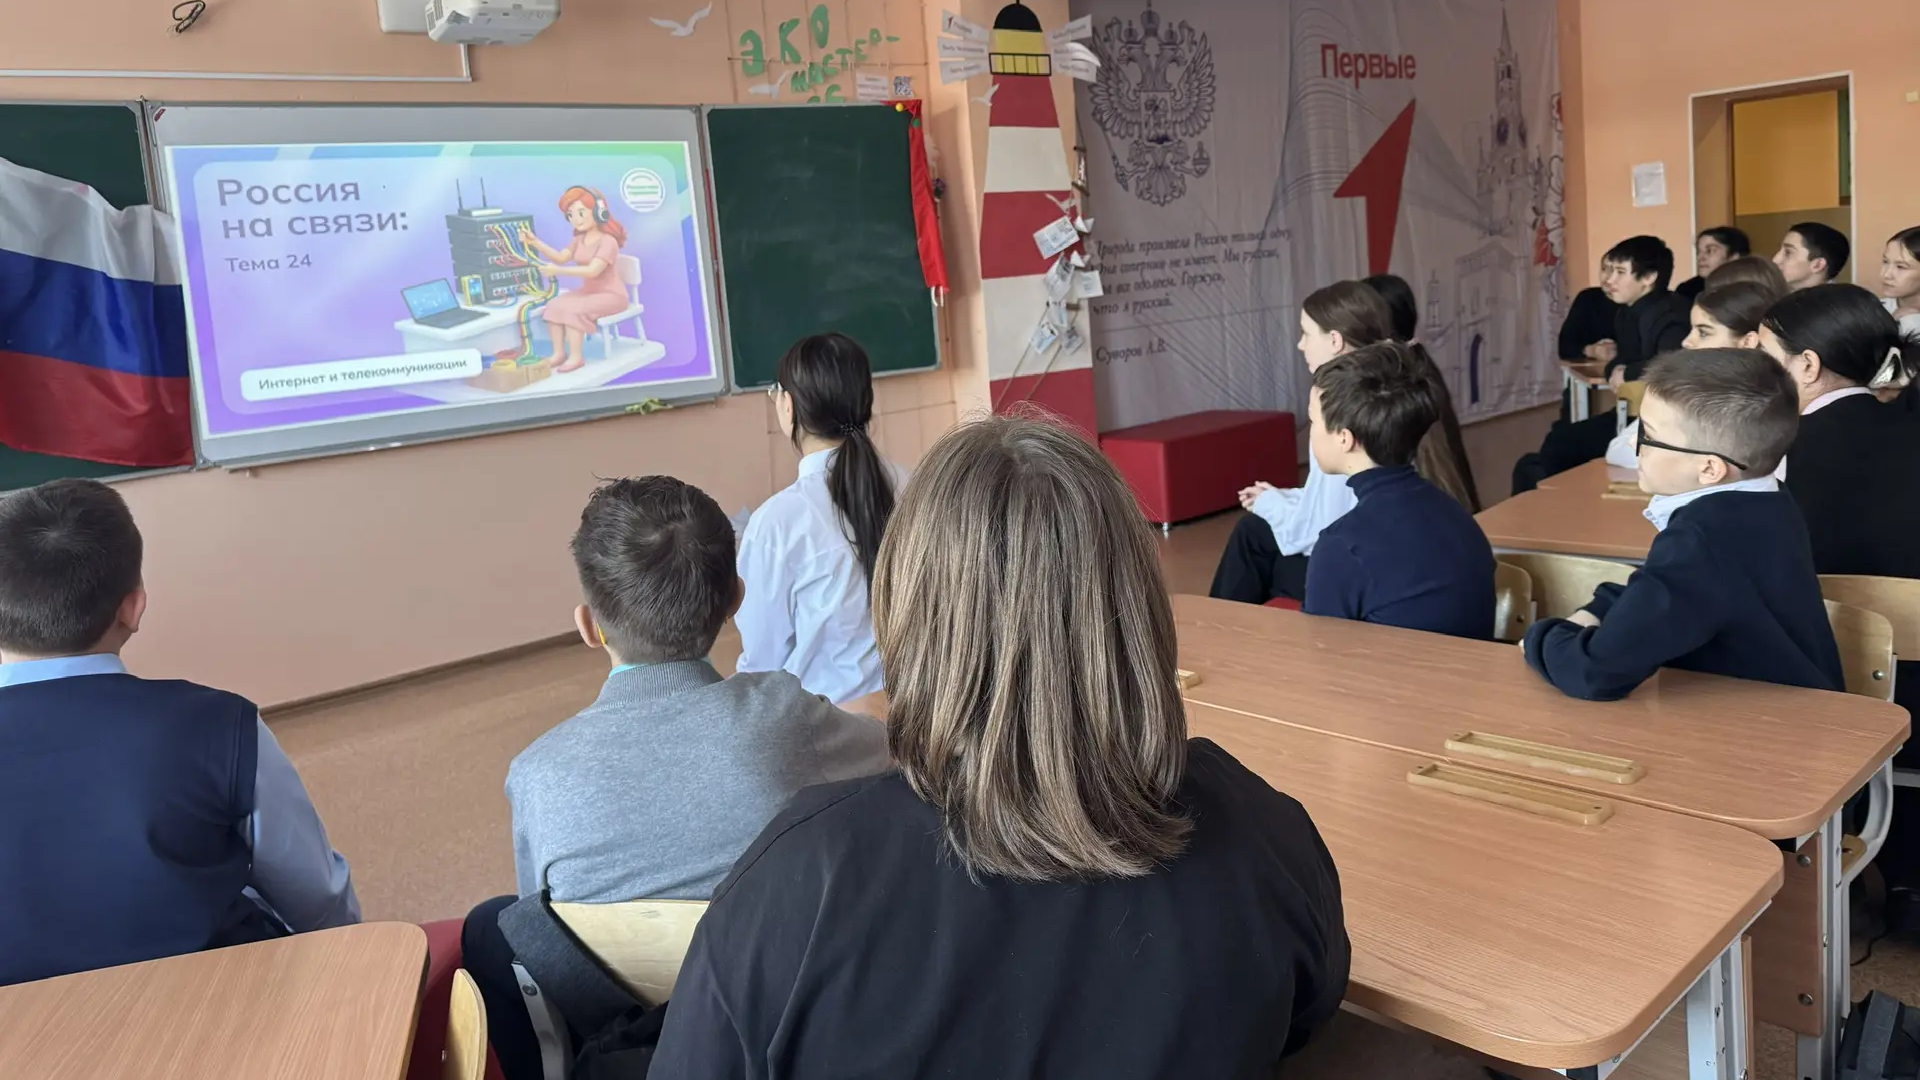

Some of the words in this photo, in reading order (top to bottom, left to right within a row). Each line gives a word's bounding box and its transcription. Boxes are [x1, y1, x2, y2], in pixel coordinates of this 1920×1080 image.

[740, 4, 830, 77] ЭКО
[1321, 44, 1416, 91] Первые
[217, 179, 361, 206] Россия
[222, 217, 273, 239] на
[287, 212, 409, 235] связи:
[225, 257, 280, 272] Тема
[286, 254, 312, 269] 24
[1096, 346, 1142, 365] Суворов
[258, 373, 326, 390] Интернет
[329, 373, 338, 382] и
[340, 358, 467, 380] телекоммуникации
